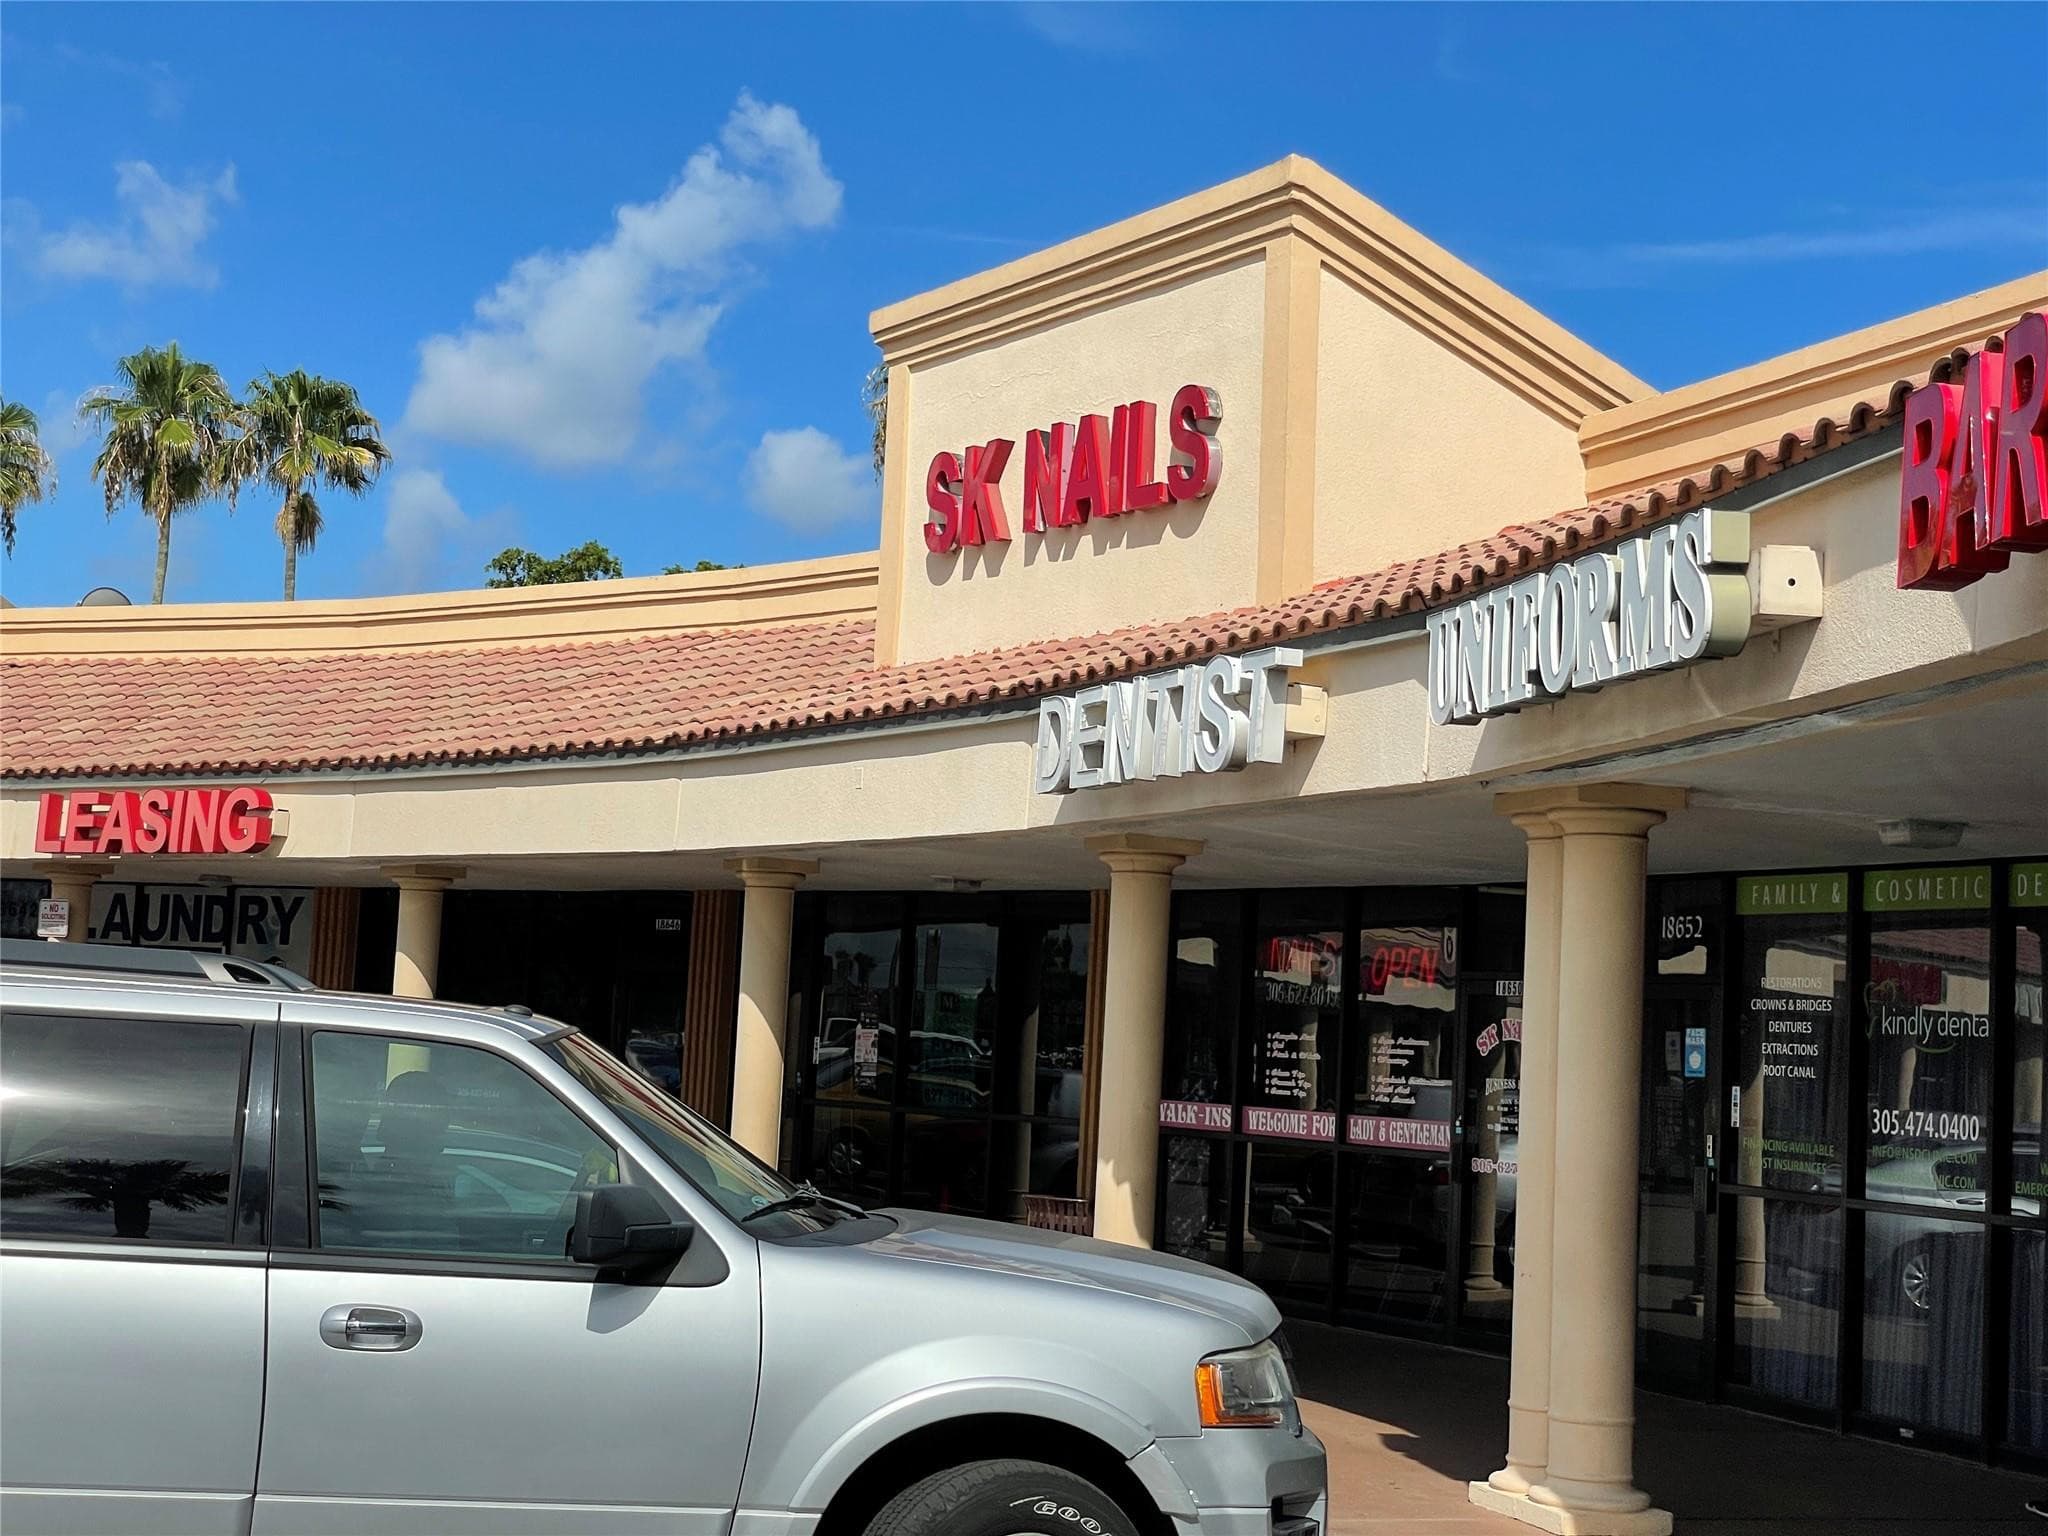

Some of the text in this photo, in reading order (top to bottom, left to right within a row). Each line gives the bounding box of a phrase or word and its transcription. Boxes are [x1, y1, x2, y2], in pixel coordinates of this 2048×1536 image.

[924, 384, 1223, 554] SK NAILS
[1427, 508, 1742, 726] UNIFORMS
[1035, 647, 1303, 795] DENTIST
[35, 786, 273, 855] LEASING
[1752, 884, 1818, 905] FAMILY
[1831, 884, 1841, 904] &
[1875, 875, 1985, 901] COSMETIC
[49, 903, 59, 912] NO
[88, 891, 305, 945] AUNDRY
[1662, 915, 1703, 939] 18652
[1270, 936, 1337, 977] NAILS
[1370, 946, 1440, 990] OPEN
[1761, 976, 1823, 989] RESTORATIONS
[1750, 998, 1832, 1011] CROWNS & BRIDGES
[1475, 1022, 1500, 1057] SK
[1768, 1020, 1812, 1034] DENTURES
[1881, 1005, 1990, 1045] kindly denta
[1761, 1042, 1819, 1056] EXTRACTIONS
[1485, 1078, 1516, 1096] BUSINESS
[1763, 1064, 1817, 1079] ROOT CANAL
[1248, 1109, 1307, 1135] WELCOME
[1312, 1111, 1335, 1137] FOR
[1349, 1117, 1376, 1141] LADY
[1378, 1120, 1387, 1142] &
[1389, 1122, 1450, 1147] GENTLEMAN
[1872, 1109, 1980, 1142] 305.474.0400
[1743, 1138, 1834, 1158] FINANCING AVAILABLE
[1773, 1157, 1826, 1175] INSURANCES
[1034, 1500, 1112, 1536] GOO
